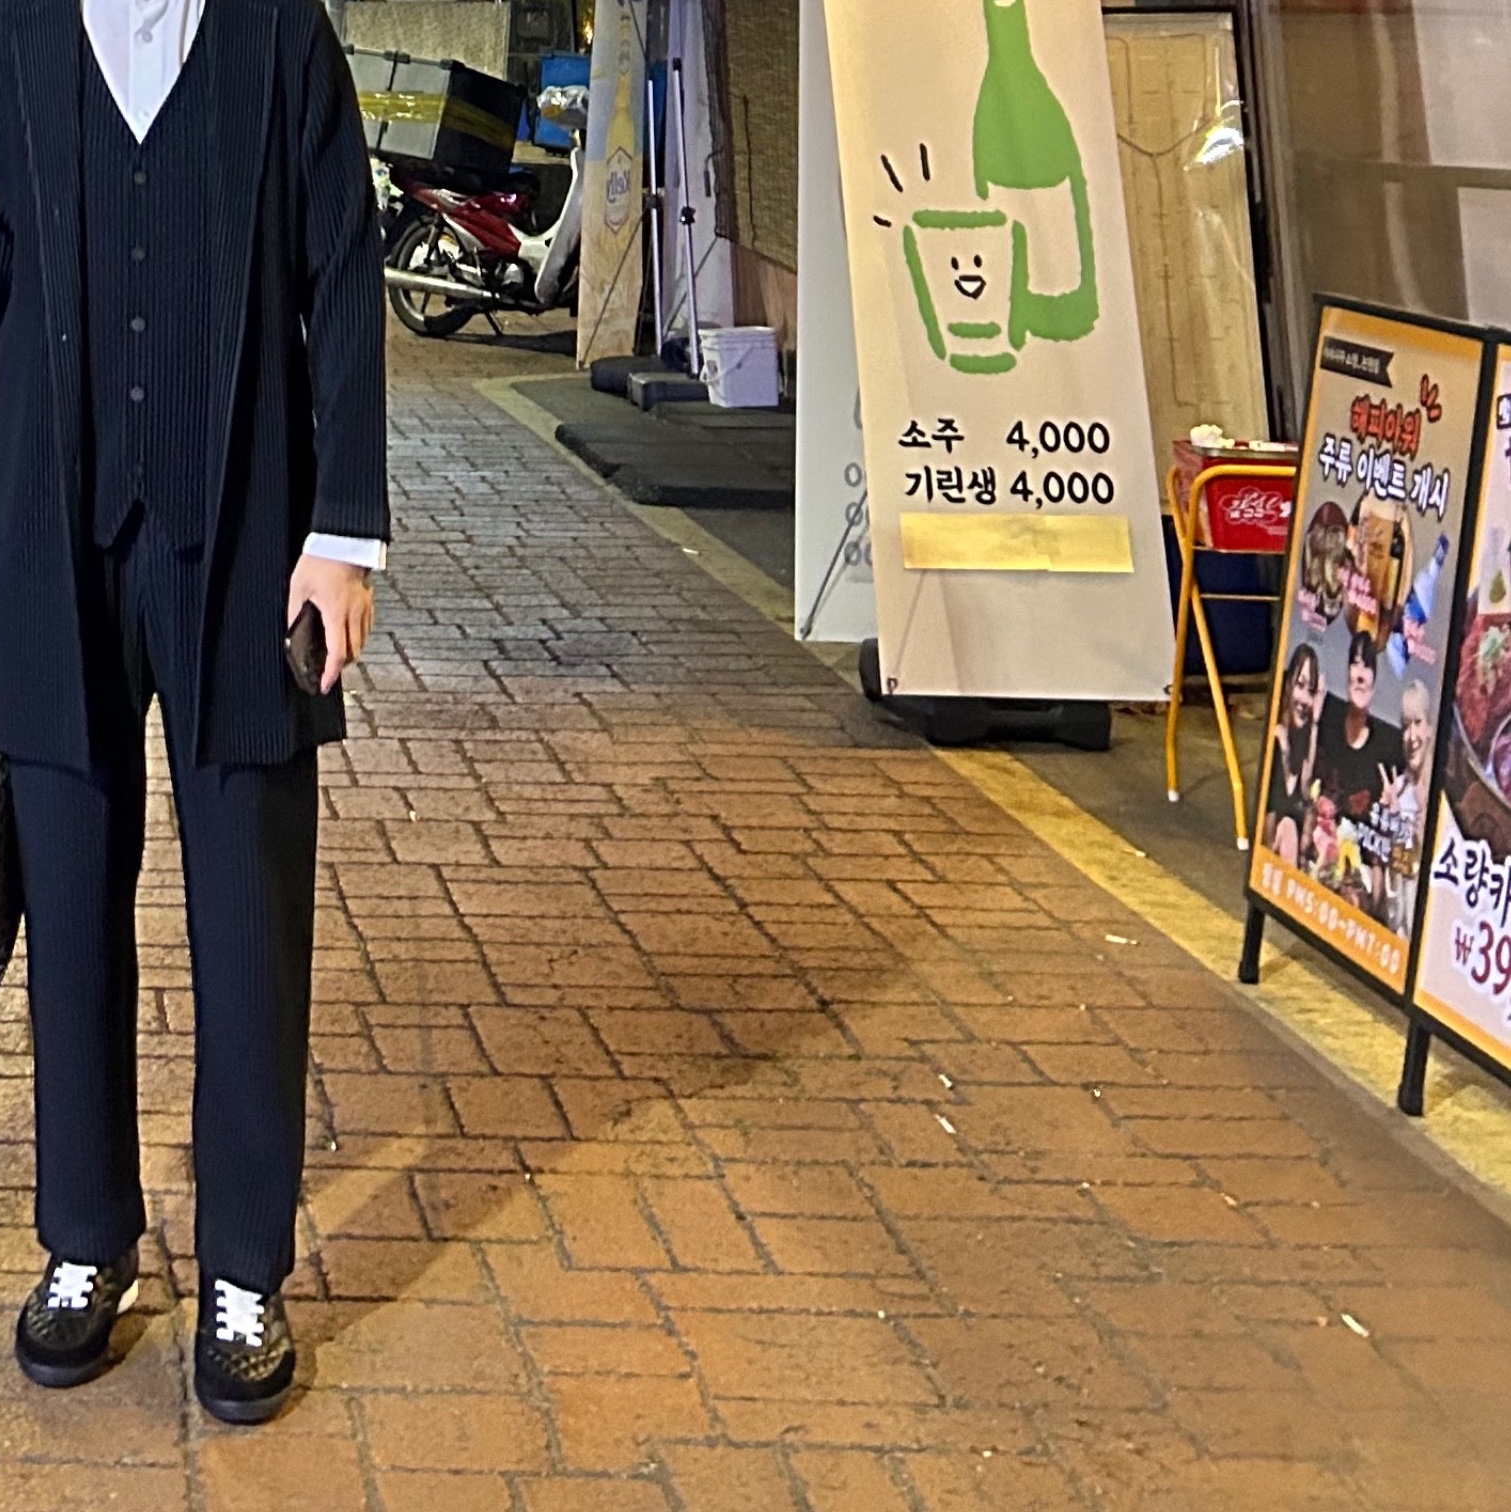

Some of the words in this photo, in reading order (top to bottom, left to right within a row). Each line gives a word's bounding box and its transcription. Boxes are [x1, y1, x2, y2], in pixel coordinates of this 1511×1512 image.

[898, 419, 965, 454] 소주
[1006, 421, 1111, 459] 4,000
[1350, 393, 1422, 462] 해피아워
[905, 466, 998, 505] 기린생
[1010, 471, 1115, 509] 4,000
[1318, 433, 1353, 488] 주류
[1357, 444, 1408, 501] 이벤트
[1409, 462, 1451, 524] 개시
